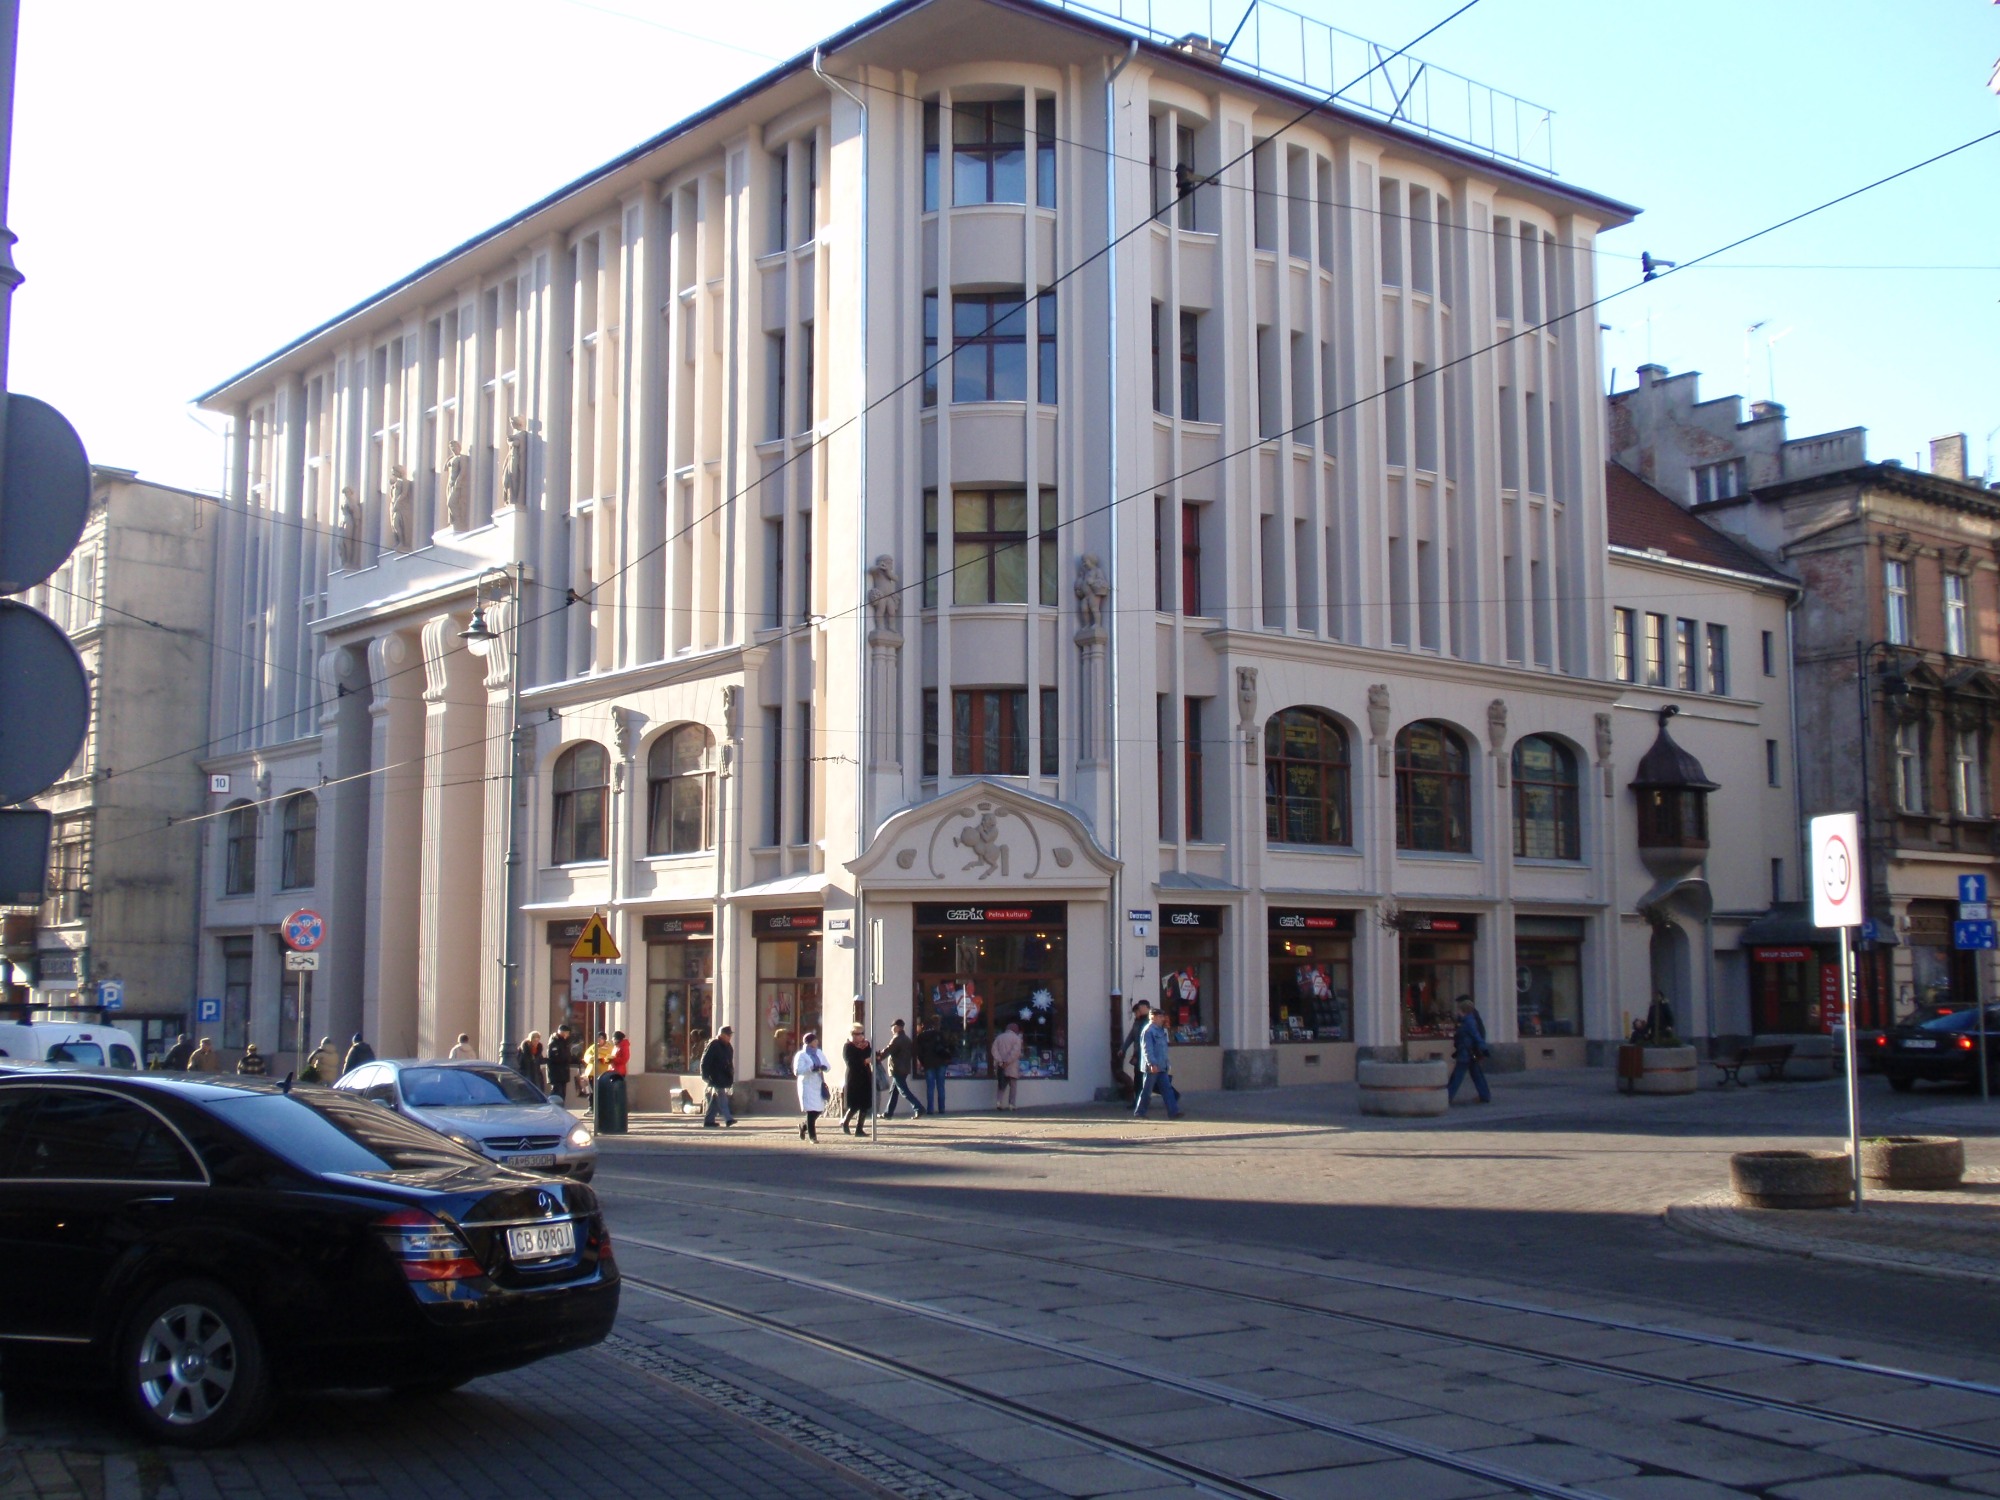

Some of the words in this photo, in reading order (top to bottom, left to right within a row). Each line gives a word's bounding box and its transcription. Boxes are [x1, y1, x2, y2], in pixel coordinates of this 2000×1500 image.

[215, 778, 226, 788] 10
[1827, 854, 1848, 886] 30
[591, 968, 623, 976] PARKING
[103, 988, 119, 1006] P
[1825, 968, 1836, 1026] LOMBARD
[202, 1002, 217, 1020] P
[516, 1231, 534, 1252] CB
[536, 1226, 571, 1250] 6980J
